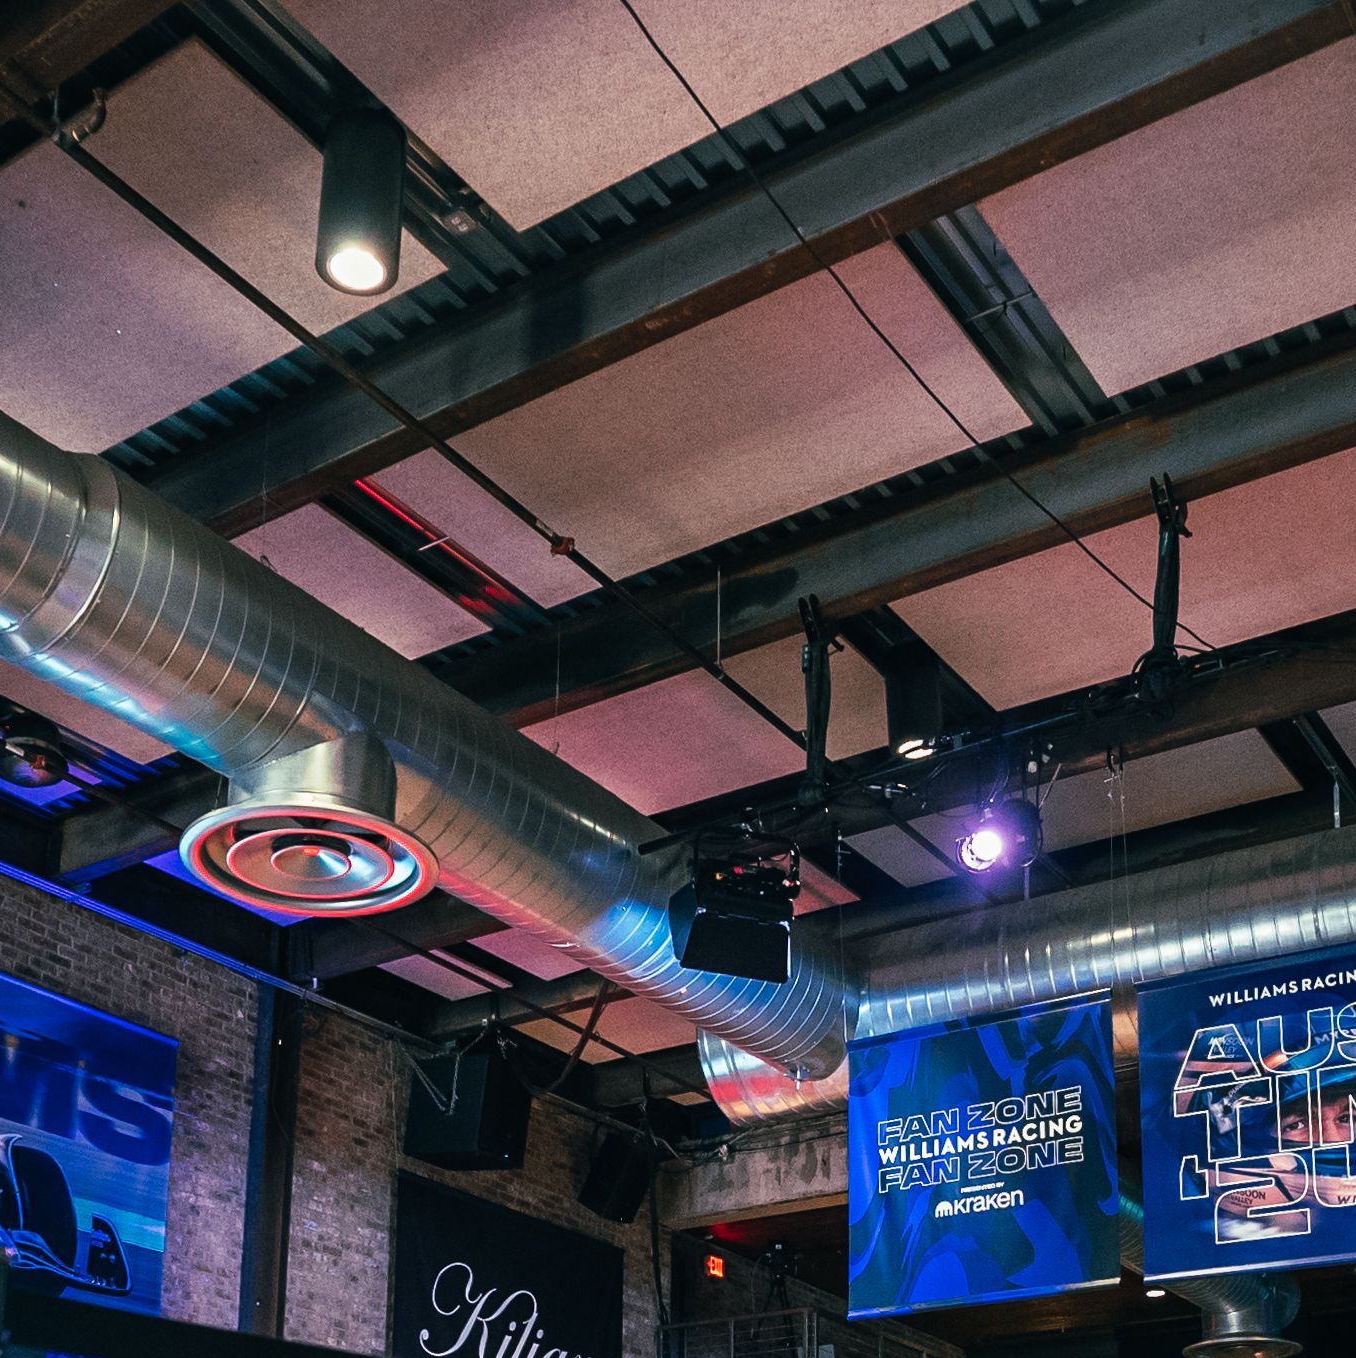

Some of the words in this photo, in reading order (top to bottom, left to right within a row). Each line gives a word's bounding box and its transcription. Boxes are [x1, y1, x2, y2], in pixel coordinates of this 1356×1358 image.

[1208, 981, 1297, 1008] WILLIAMS
[878, 1108, 960, 1147] FAN
[967, 1086, 1083, 1130] ZONE
[878, 1130, 988, 1165] WILLIAMS
[992, 1115, 1084, 1148] RACING
[879, 1156, 961, 1194] FAN
[968, 1136, 1085, 1180] ZONE
[953, 1189, 1025, 1216] kraken
